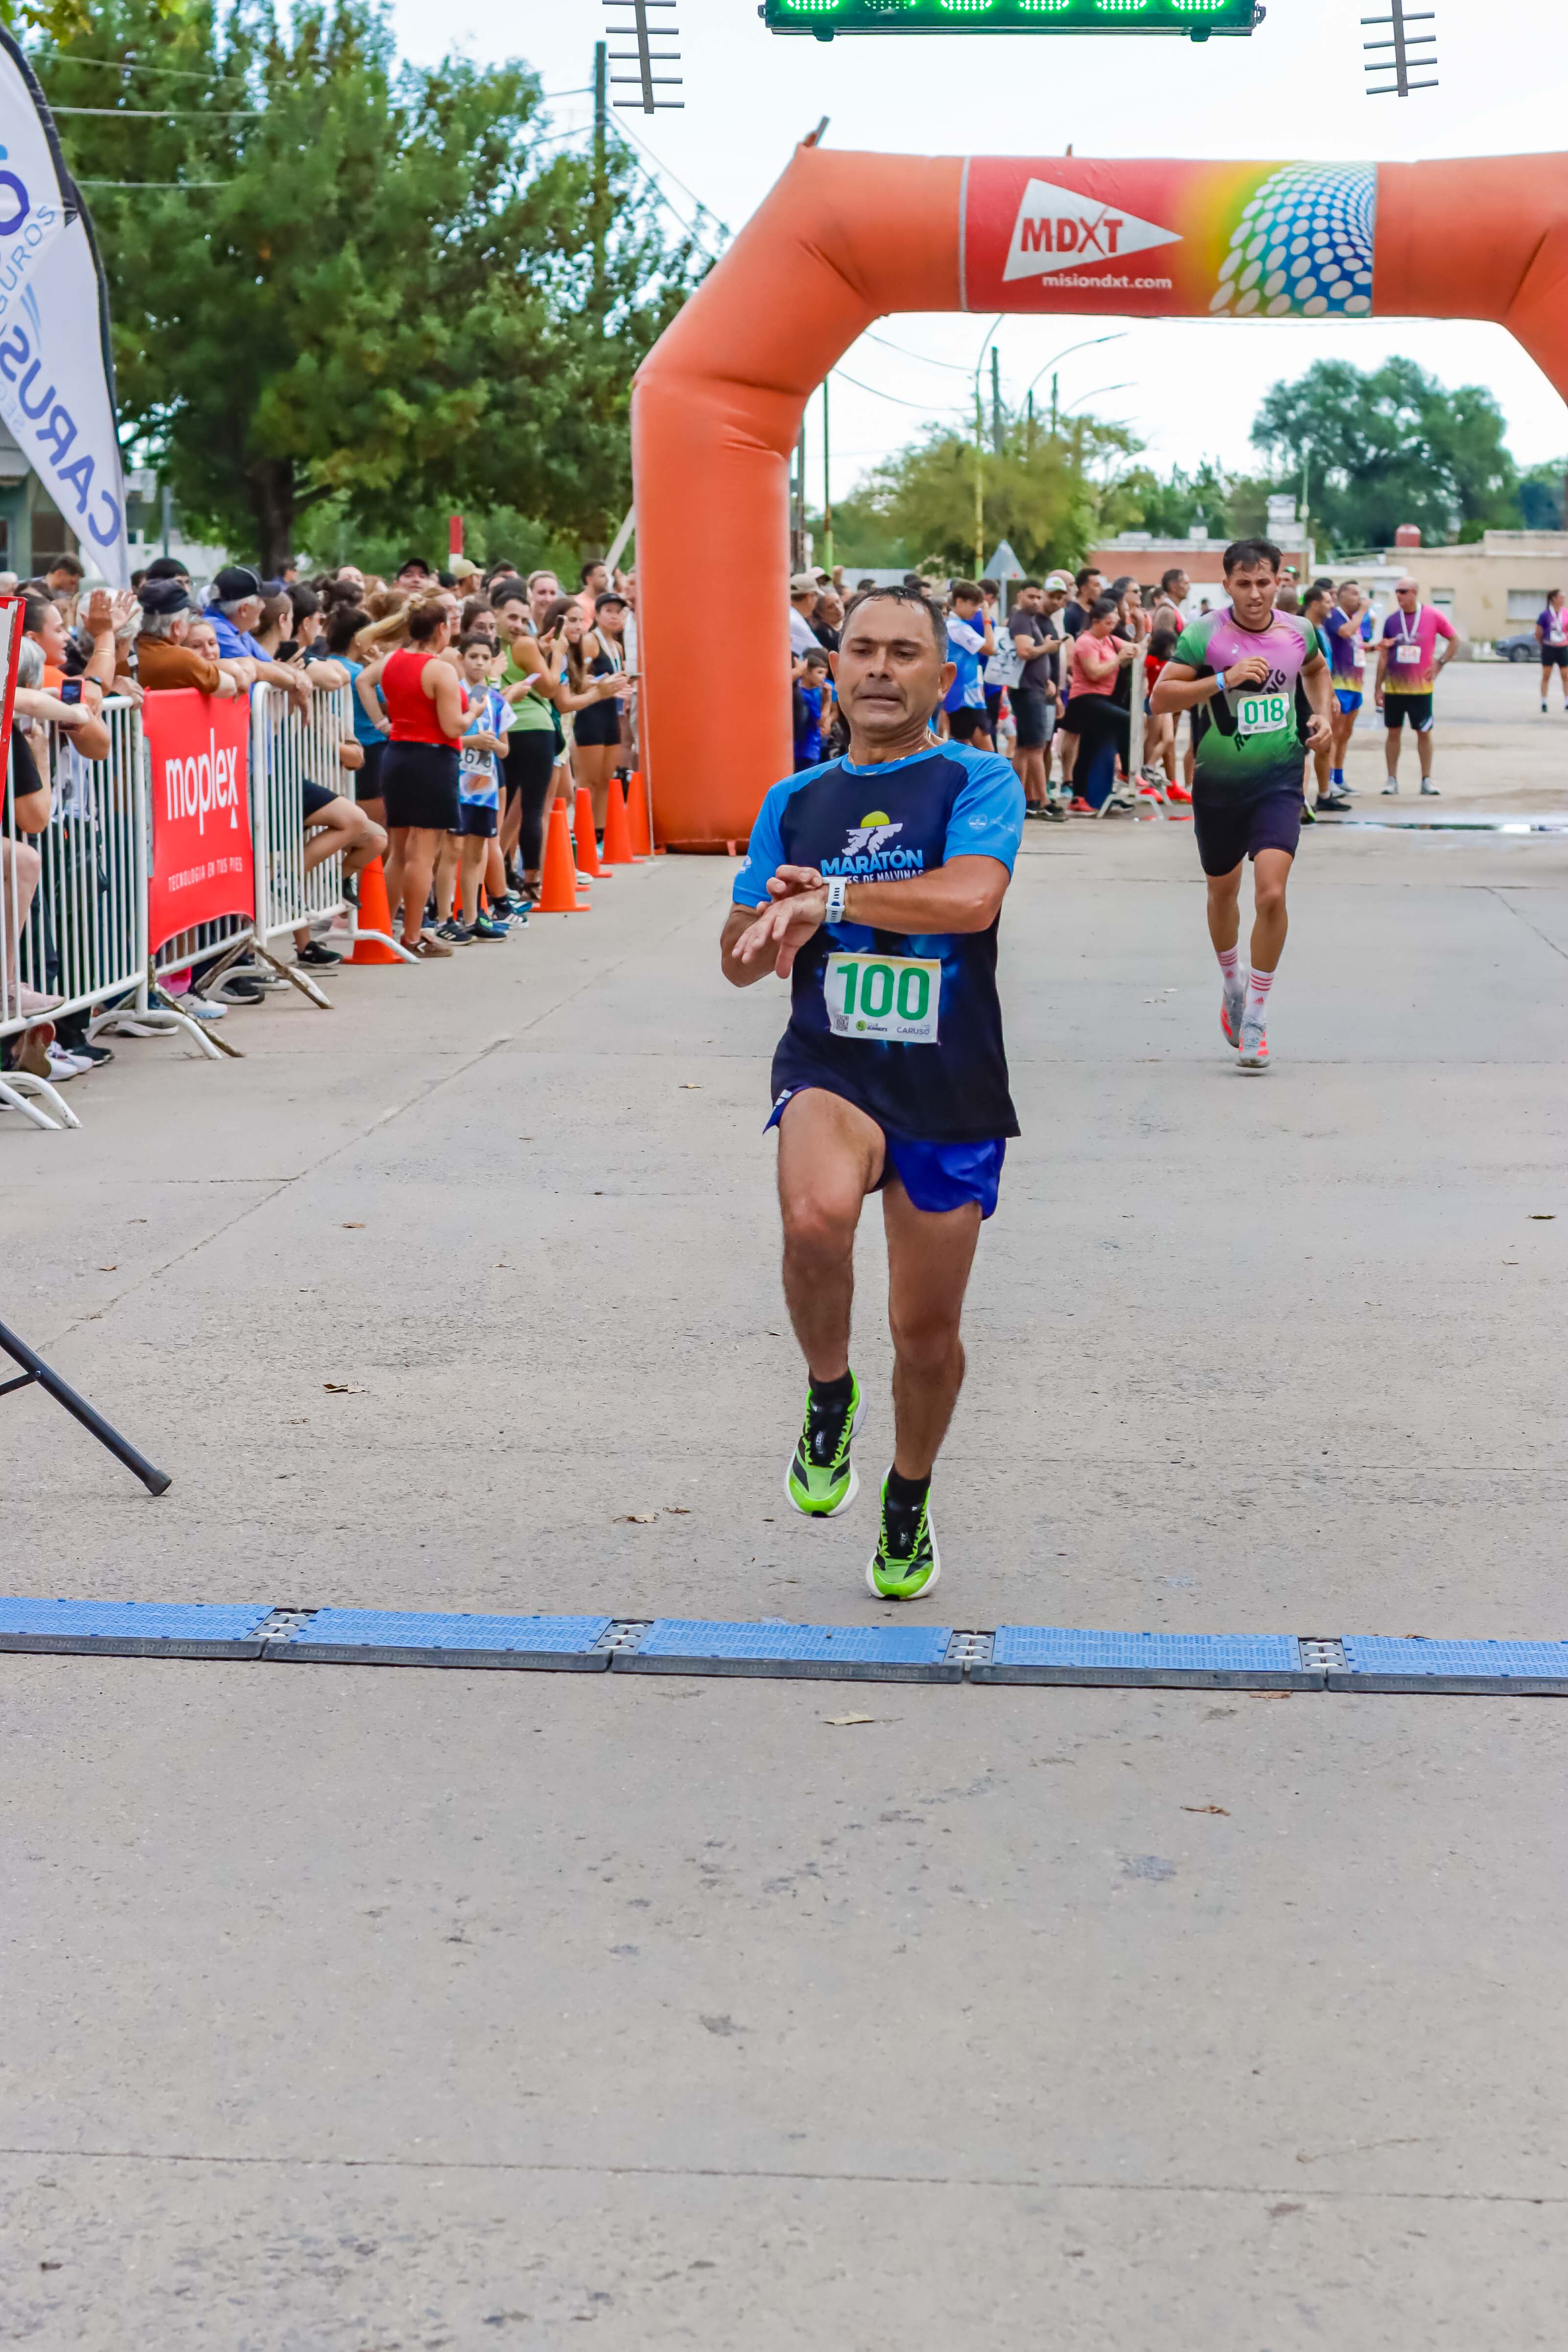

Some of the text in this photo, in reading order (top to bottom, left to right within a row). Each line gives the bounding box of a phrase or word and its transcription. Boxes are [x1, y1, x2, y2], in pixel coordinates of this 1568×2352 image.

[1021, 206, 1123, 256] MDXT
[1042, 273, 1172, 289] misiondxt.com
[1244, 698, 1284, 724] 018
[165, 727, 239, 835] moplex
[820, 845, 924, 877] MARATÓN
[837, 962, 930, 1020] 100
[896, 1027, 930, 1035] CARUSO
